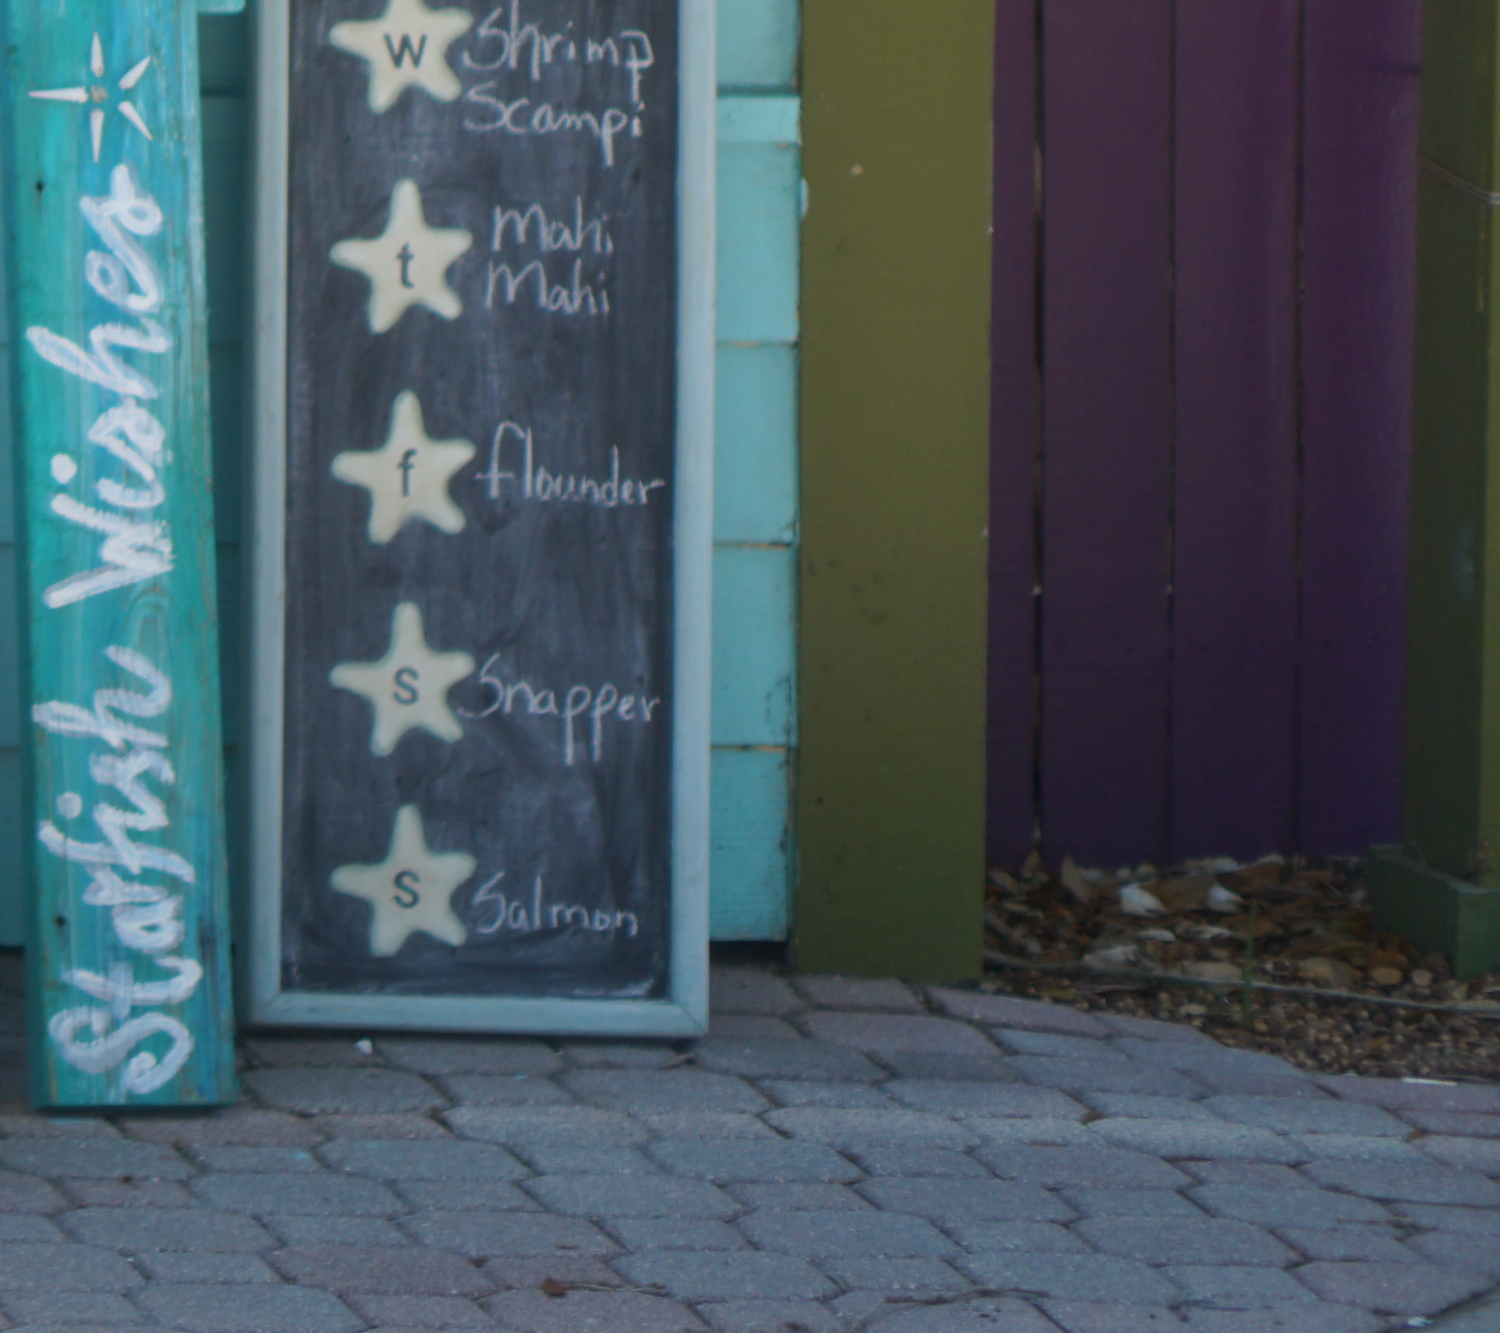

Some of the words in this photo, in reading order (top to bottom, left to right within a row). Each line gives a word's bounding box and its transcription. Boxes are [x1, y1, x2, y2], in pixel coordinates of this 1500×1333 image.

[383, 32, 428, 70] w
[463, 81, 645, 168] Scampi
[396, 242, 414, 290] t
[24, 162, 175, 610] Wishes
[397, 448, 418, 499] f
[458, 653, 662, 767] Snapper
[31, 645, 203, 1099] Starfish
[471, 871, 639, 939] Salmon
